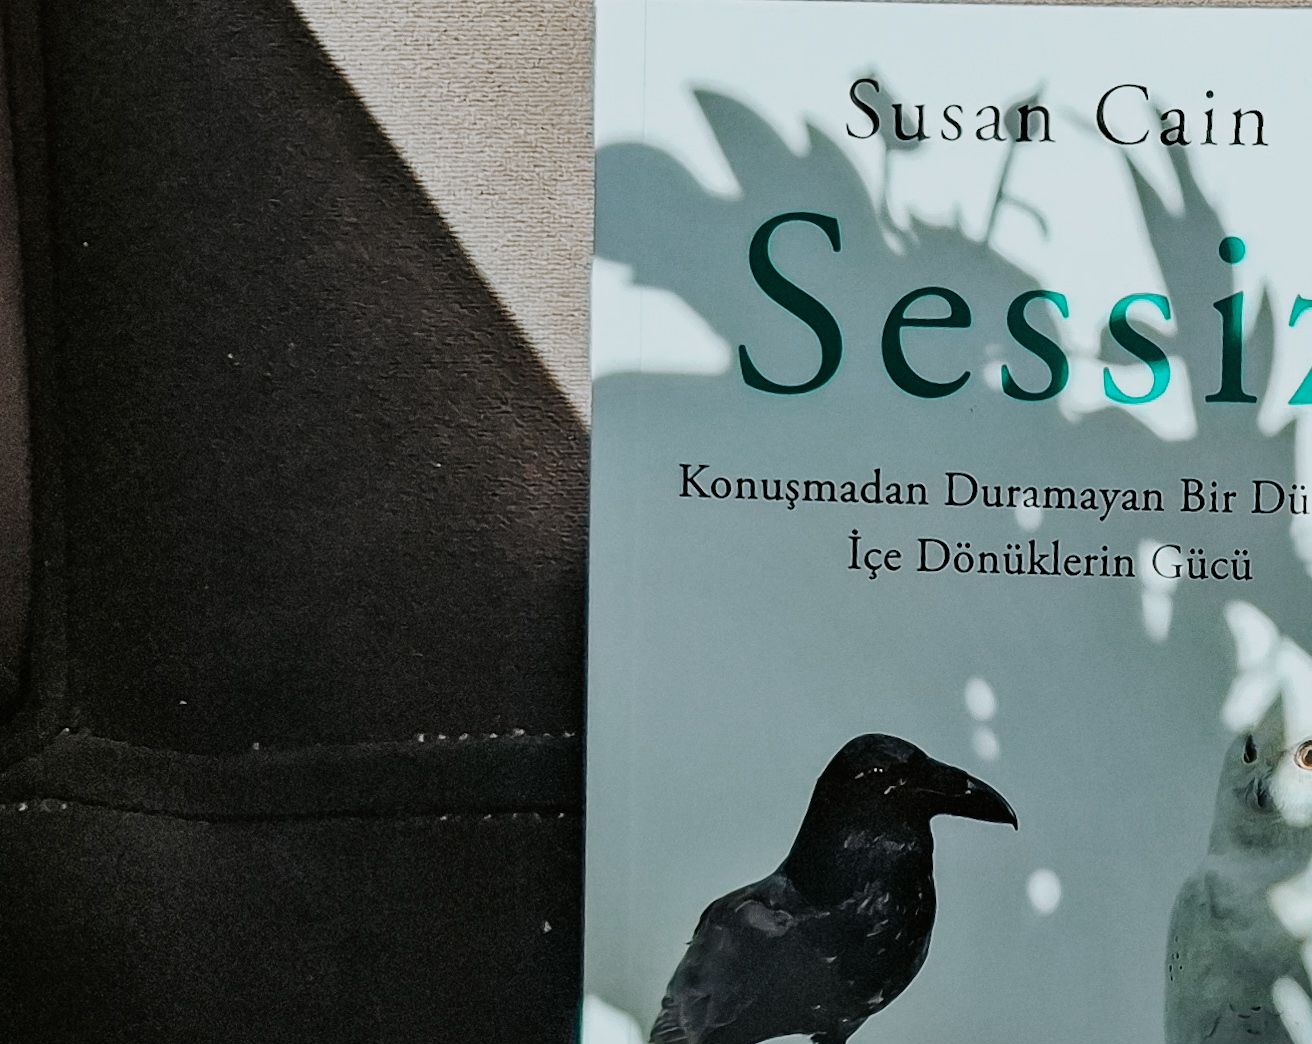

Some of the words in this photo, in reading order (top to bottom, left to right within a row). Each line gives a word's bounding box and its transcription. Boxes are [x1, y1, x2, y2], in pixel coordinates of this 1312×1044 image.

[845, 77, 1056, 144] Susan
[1095, 83, 1270, 148] Cain
[677, 463, 928, 511] Konuşmadan
[943, 471, 1165, 522] Duramayan
[1179, 477, 1237, 514] Bir
[846, 529, 902, 581] İçe
[915, 537, 1135, 579] Dönüklerin
[1151, 544, 1253, 581] Gücü
